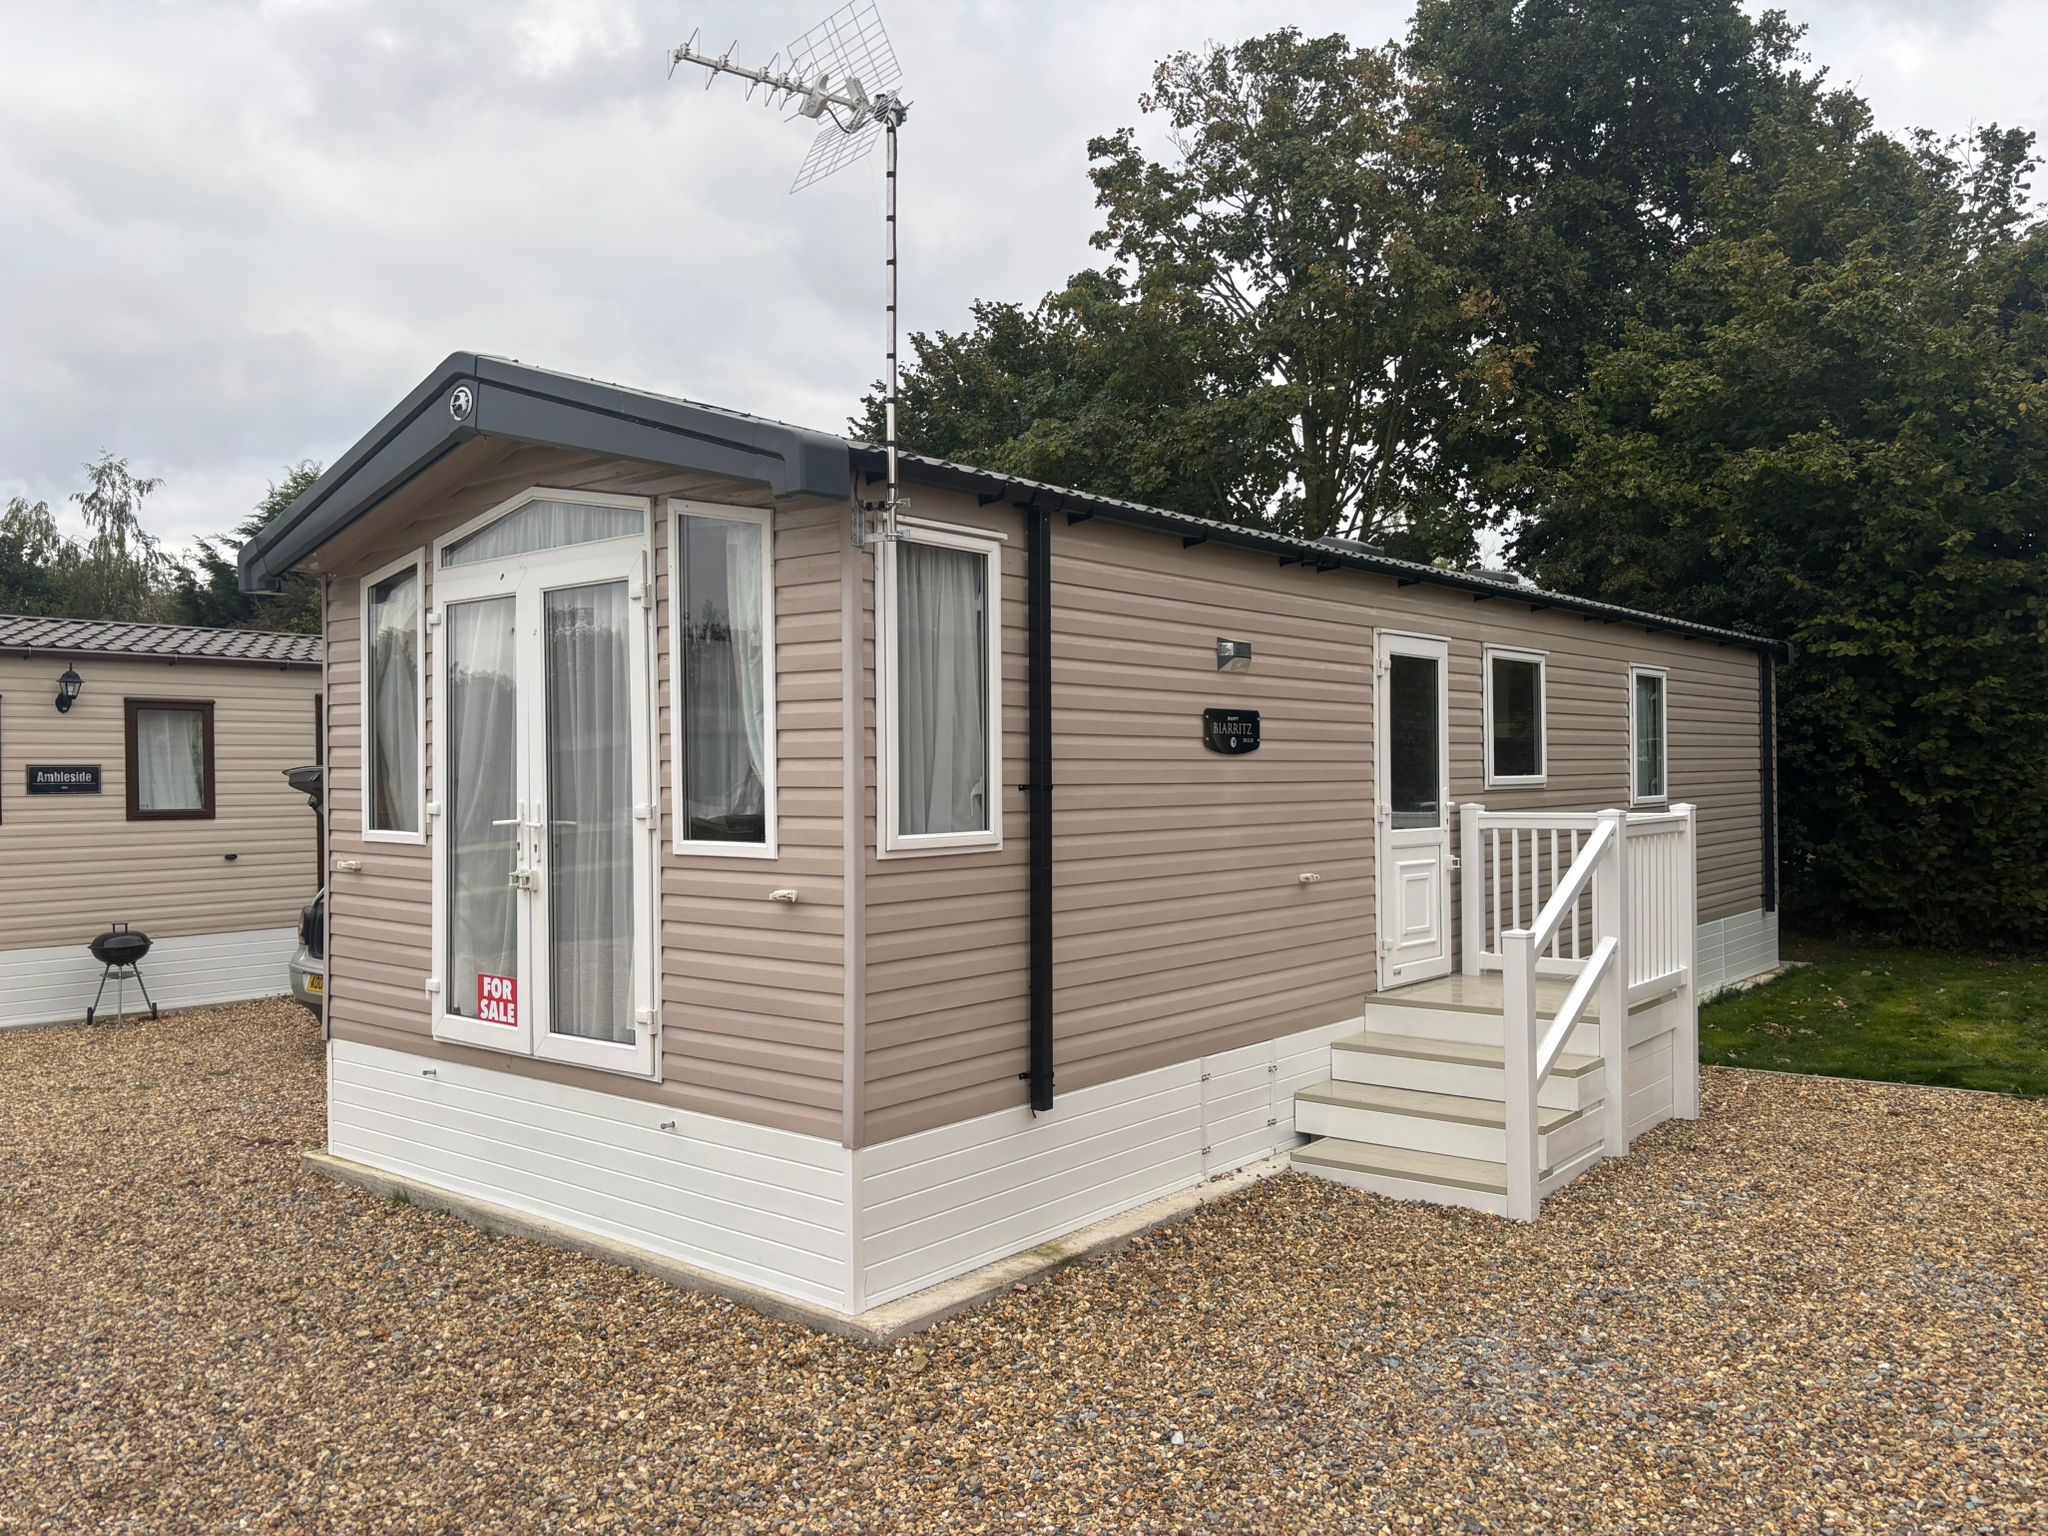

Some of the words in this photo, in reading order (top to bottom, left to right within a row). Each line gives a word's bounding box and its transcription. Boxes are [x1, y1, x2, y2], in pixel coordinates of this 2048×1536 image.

[1213, 722, 1253, 735] BIARRITZ
[36, 771, 92, 783] Ambleside
[483, 976, 513, 1001] FOR
[480, 998, 515, 1024] SALE
